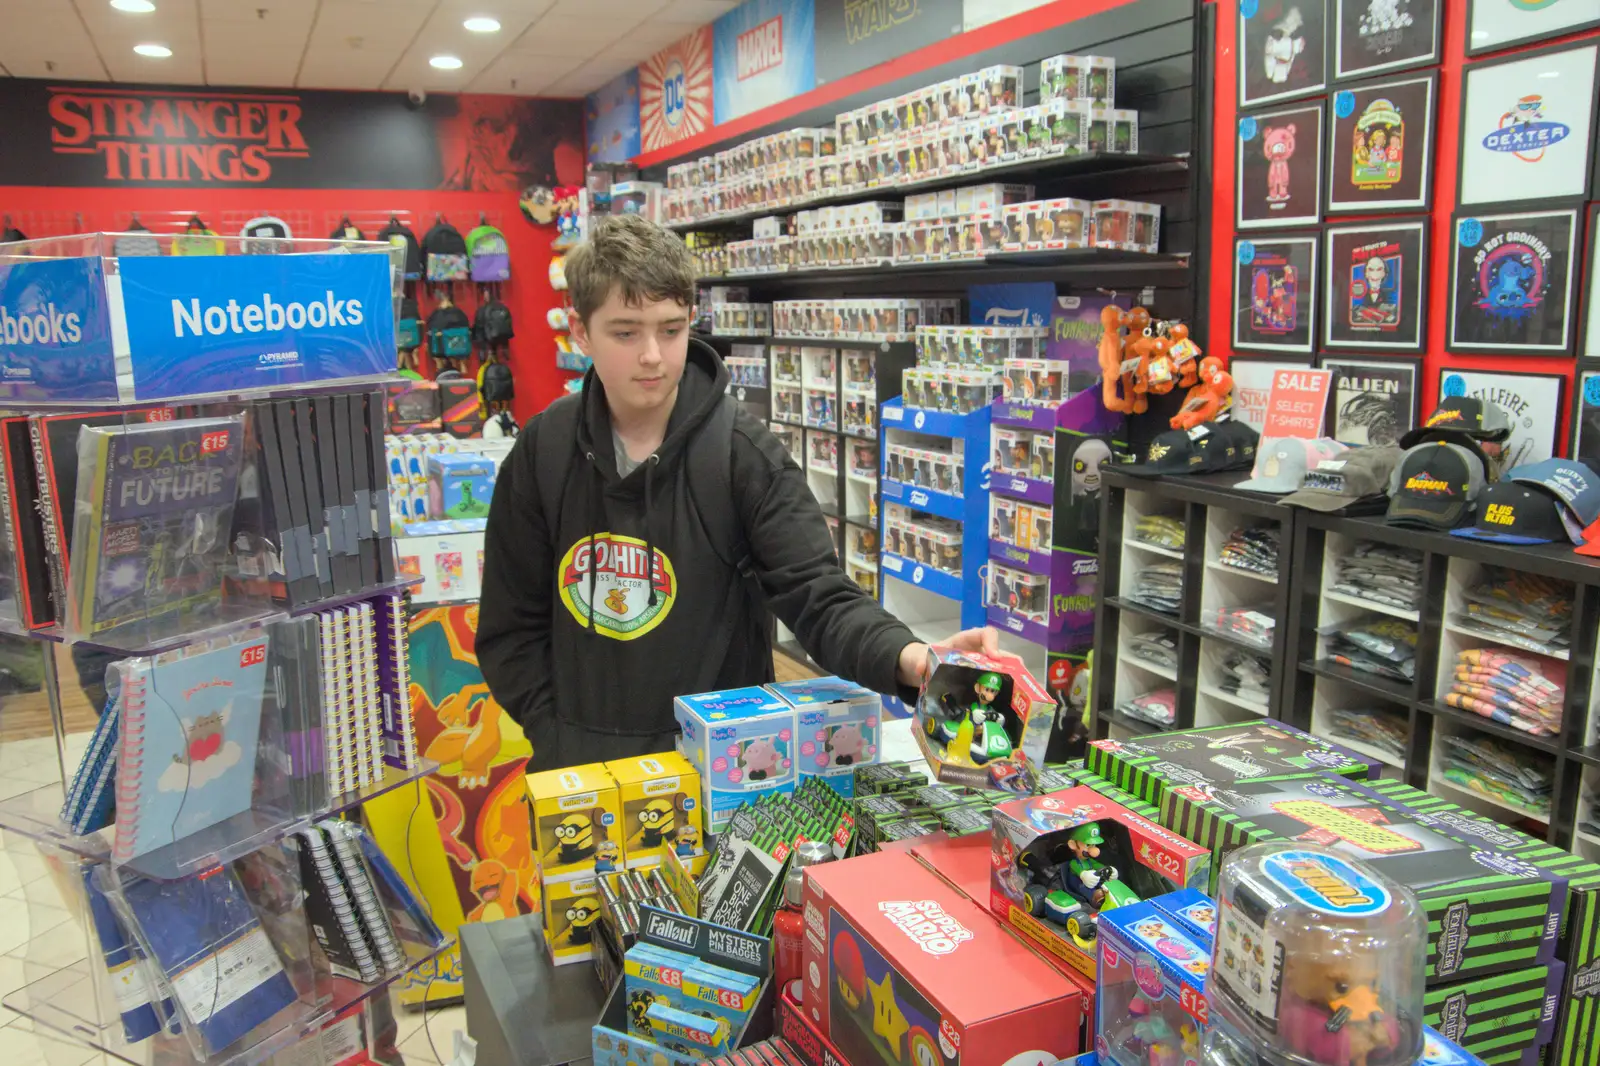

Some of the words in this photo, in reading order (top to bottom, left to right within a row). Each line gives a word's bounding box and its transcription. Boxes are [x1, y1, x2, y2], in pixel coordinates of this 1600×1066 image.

[738, 17, 781, 80] MARVEL
[664, 74, 684, 113] DC
[49, 94, 309, 150] STRANGER
[1487, 127, 1564, 147] DEXTER
[97, 140, 271, 182] THINGS
[1474, 249, 1486, 265] SO
[1484, 234, 1504, 252] NOT
[0, 303, 81, 345] books
[172, 291, 363, 337] Notebooks
[1278, 373, 1322, 392] SALE
[1338, 376, 1399, 394] ALIEN
[1275, 400, 1314, 413] SELECT
[1270, 414, 1315, 429] T-SHIRTS
[132, 441, 217, 469] BAC
[203, 435, 228, 450] €15
[31, 427, 60, 554] GHOSTBUSTERS
[120, 468, 223, 507] FUTURE
[1406, 477, 1449, 491] BATMAN
[1485, 513, 1515, 525] ULTRA
[1488, 503, 1513, 516] PLUS
[242, 648, 264, 663] €15
[836, 828, 847, 844] €15
[776, 846, 787, 860] €15
[1155, 852, 1179, 876] €22
[729, 893, 743, 914] BIG
[734, 881, 752, 907] ONE
[713, 909, 731, 928] ROO
[720, 900, 741, 928] DARK
[915, 900, 974, 944] SUPER
[1544, 912, 1560, 940] LIGHT
[649, 915, 694, 944] Fallout
[879, 900, 959, 956] MARIO
[1443, 911, 1461, 969] BEETLEJUICE
[709, 930, 761, 953] MYSTERY
[709, 940, 724, 951] PIN
[726, 945, 761, 961] BADGES
[661, 970, 681, 986] €8
[721, 991, 741, 1008] €8
[1181, 989, 1208, 1020] €12
[1542, 994, 1556, 1022] LIGHT
[688, 1030, 710, 1045] €8
[941, 1020, 961, 1050] €28
